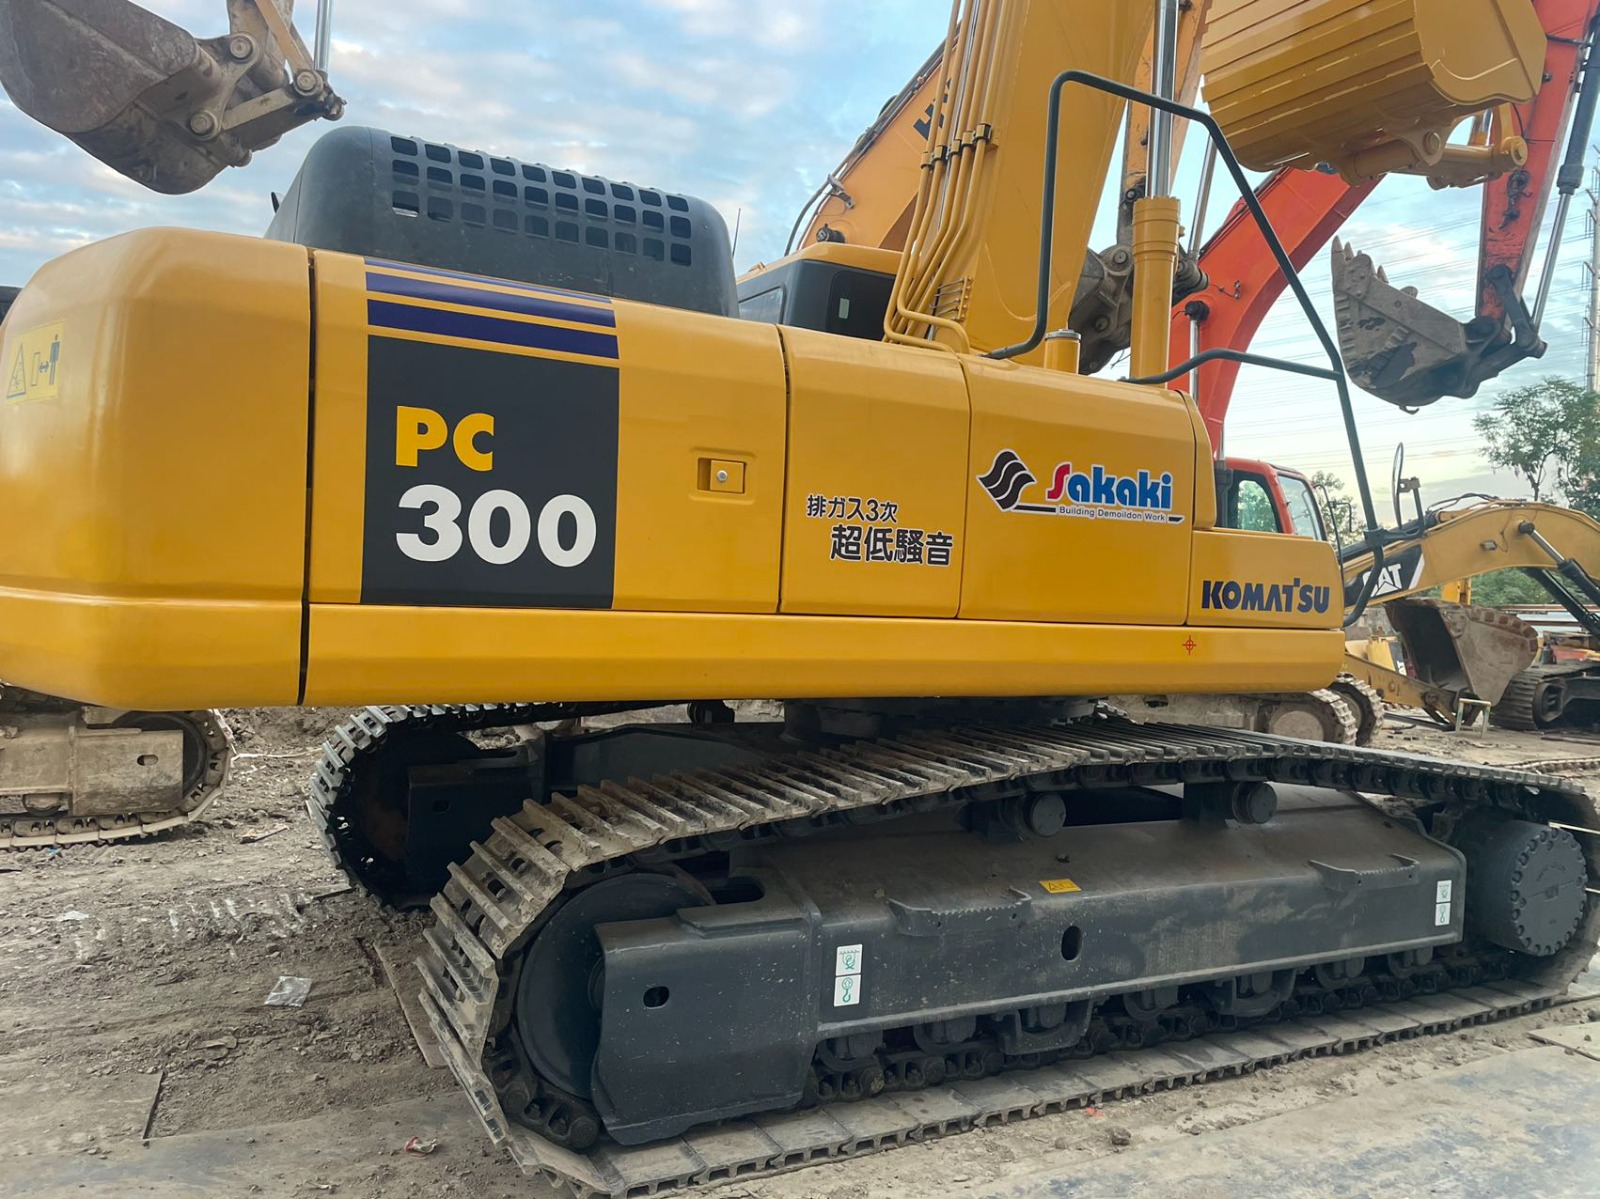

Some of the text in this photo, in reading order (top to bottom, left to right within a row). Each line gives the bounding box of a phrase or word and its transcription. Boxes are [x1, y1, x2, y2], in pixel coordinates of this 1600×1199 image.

[396, 405, 494, 472] PC
[1047, 463, 1172, 510] Sakaki
[396, 484, 597, 568] 300
[806, 494, 899, 524] 排ガス3次
[1060, 506, 1095, 517] Building
[1144, 513, 1165, 521] Work
[830, 524, 953, 566] 超低騒音
[1201, 577, 1330, 614] KOMATSU
